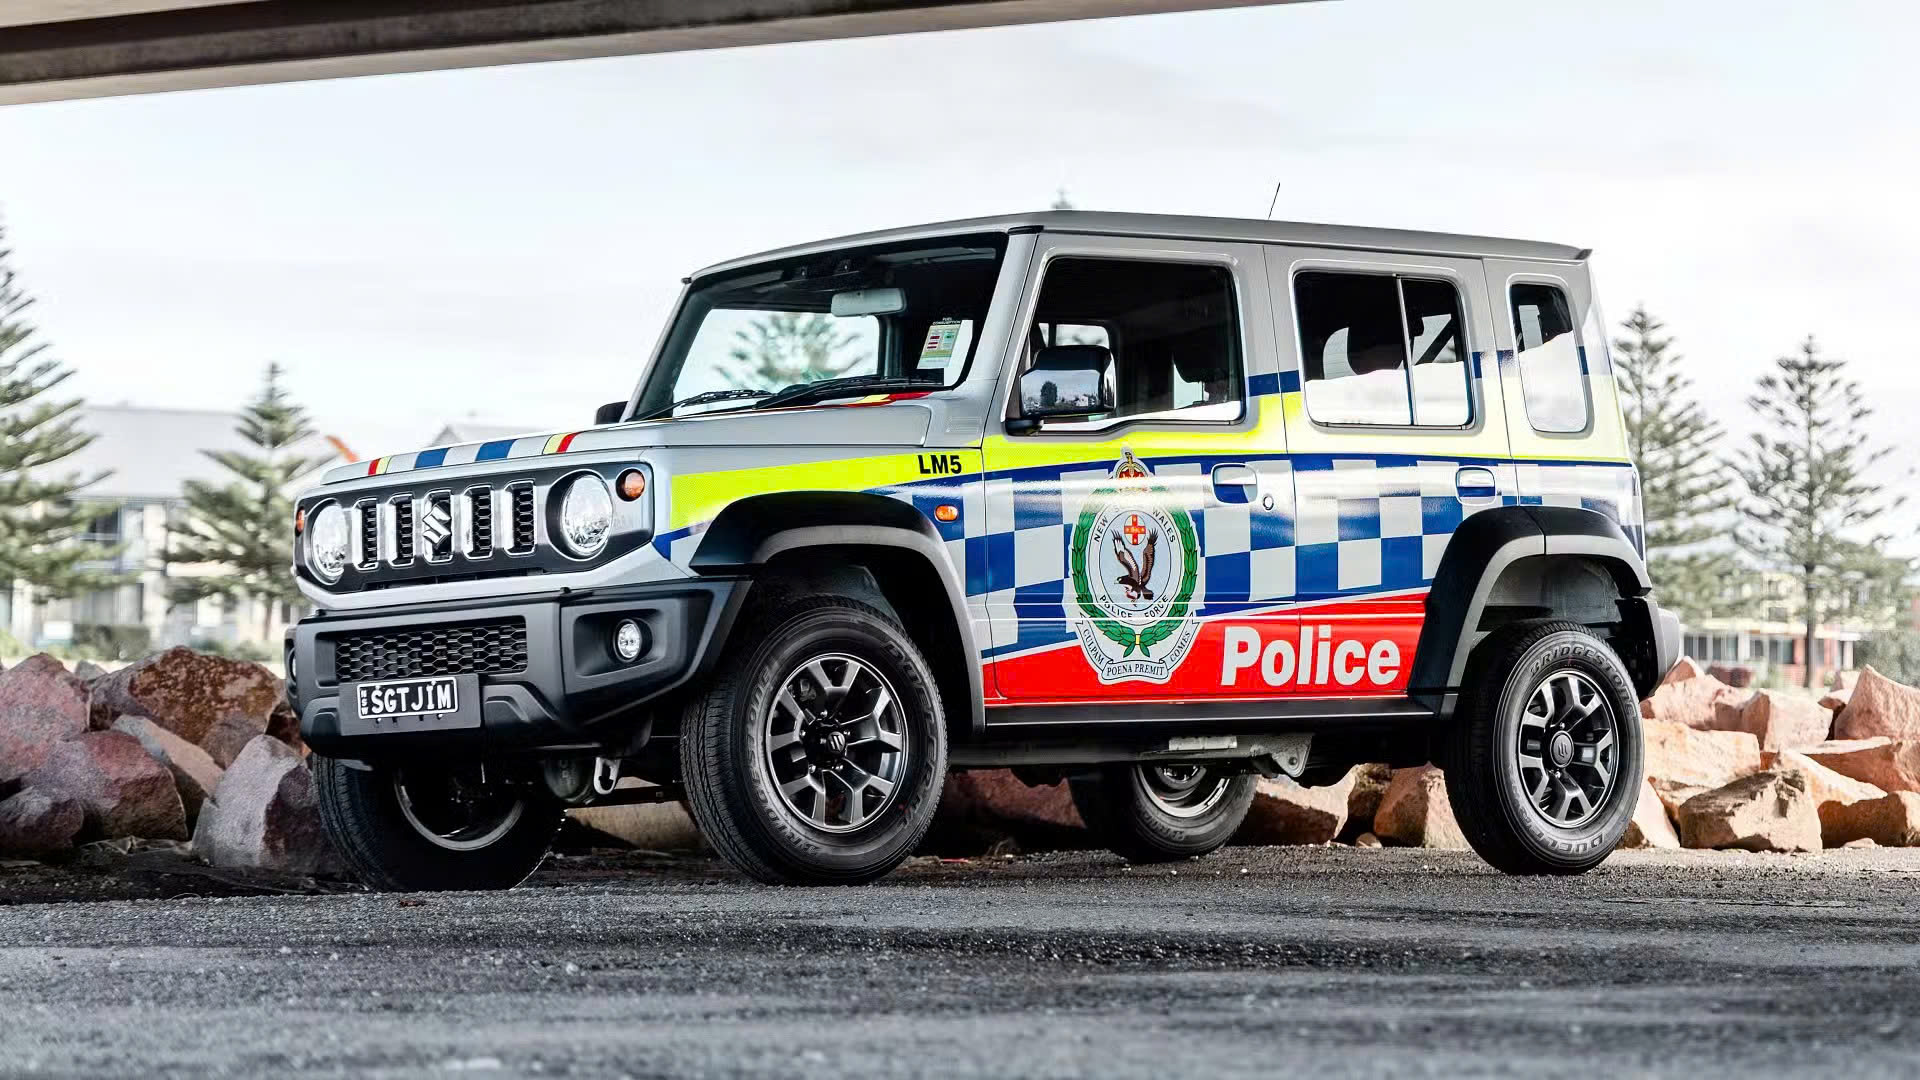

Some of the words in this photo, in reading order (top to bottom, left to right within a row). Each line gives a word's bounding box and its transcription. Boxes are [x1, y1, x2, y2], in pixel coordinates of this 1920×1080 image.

[917, 454, 962, 475] LM5
[1093, 514, 1108, 542] NEW
[1152, 507, 1176, 543] WALES
[1099, 595, 1133, 618] POLICE
[1144, 594, 1169, 618] FORCE
[1083, 628, 1105, 665] CULPAM
[1107, 664, 1133, 677] POENA
[1134, 662, 1165, 677] PREMIT
[1169, 631, 1191, 663] COMES
[1220, 624, 1401, 687] Police
[1529, 644, 1637, 717] BRIDGESTONE
[884, 640, 938, 790] DUELER
[745, 664, 820, 856] BRIDGESTONE
